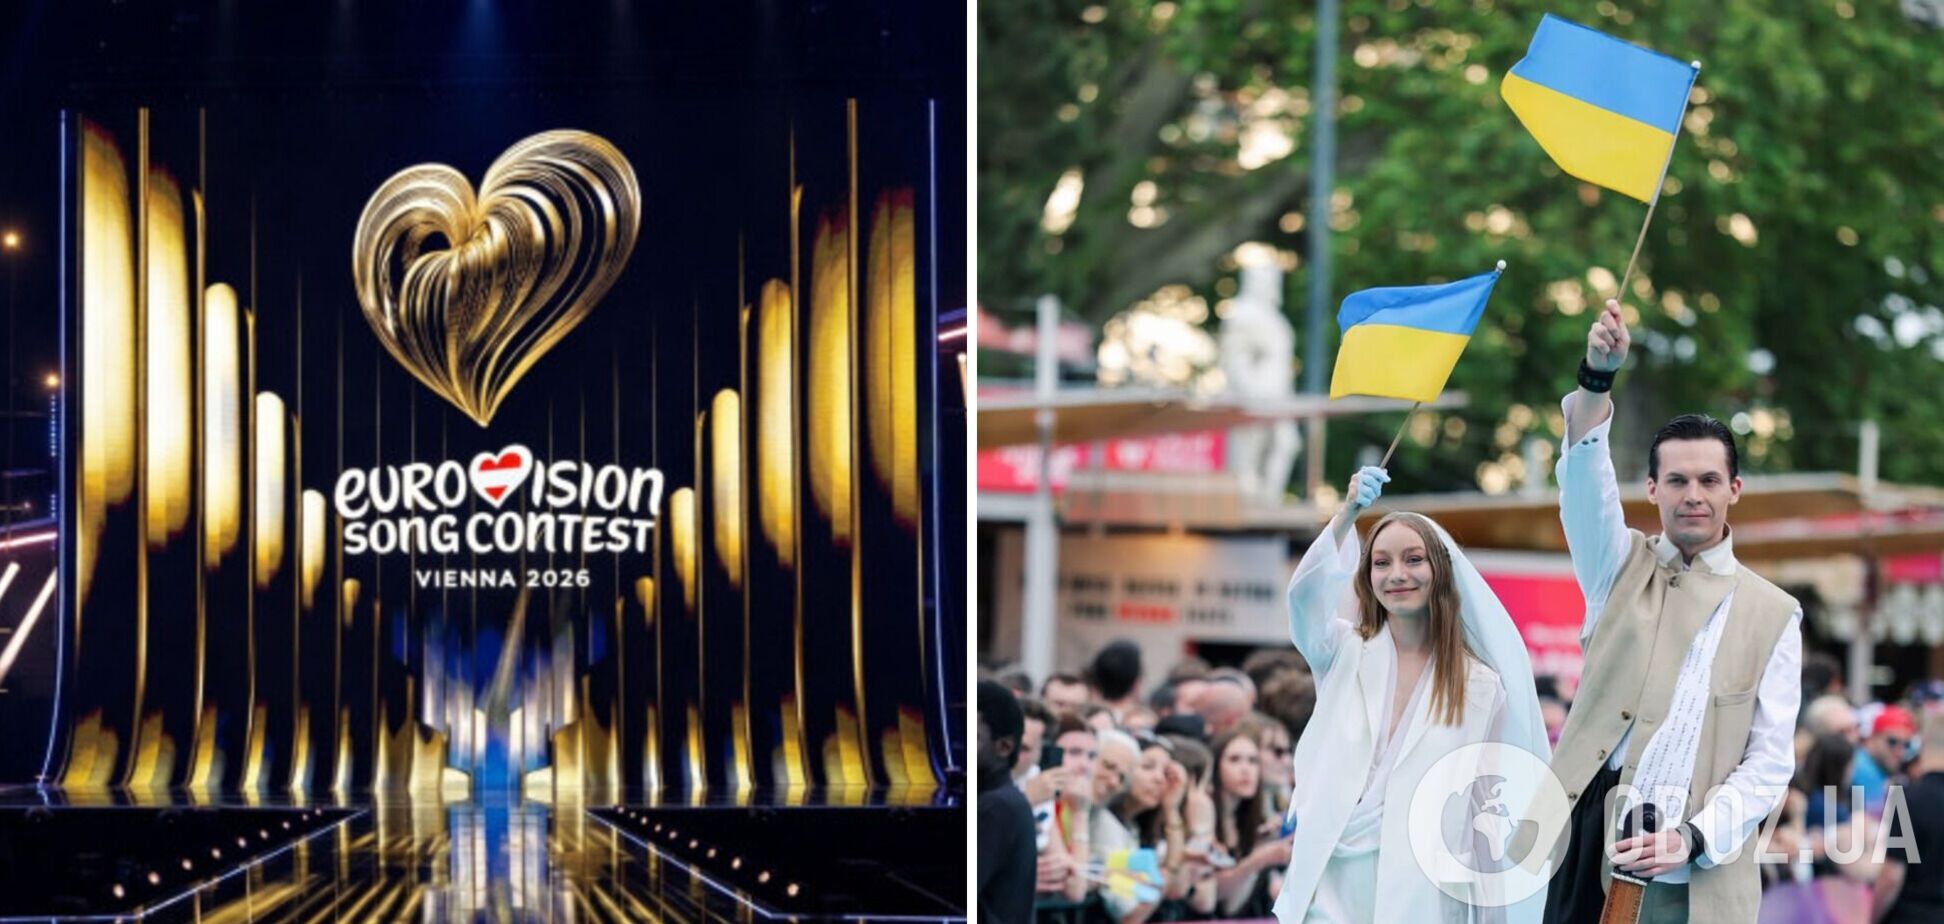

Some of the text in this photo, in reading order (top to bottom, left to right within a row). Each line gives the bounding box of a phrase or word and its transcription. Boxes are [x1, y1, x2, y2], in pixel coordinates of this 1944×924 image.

[343, 511, 656, 554] SONG CONTEST
[415, 569, 590, 588] VIENNA 2026
